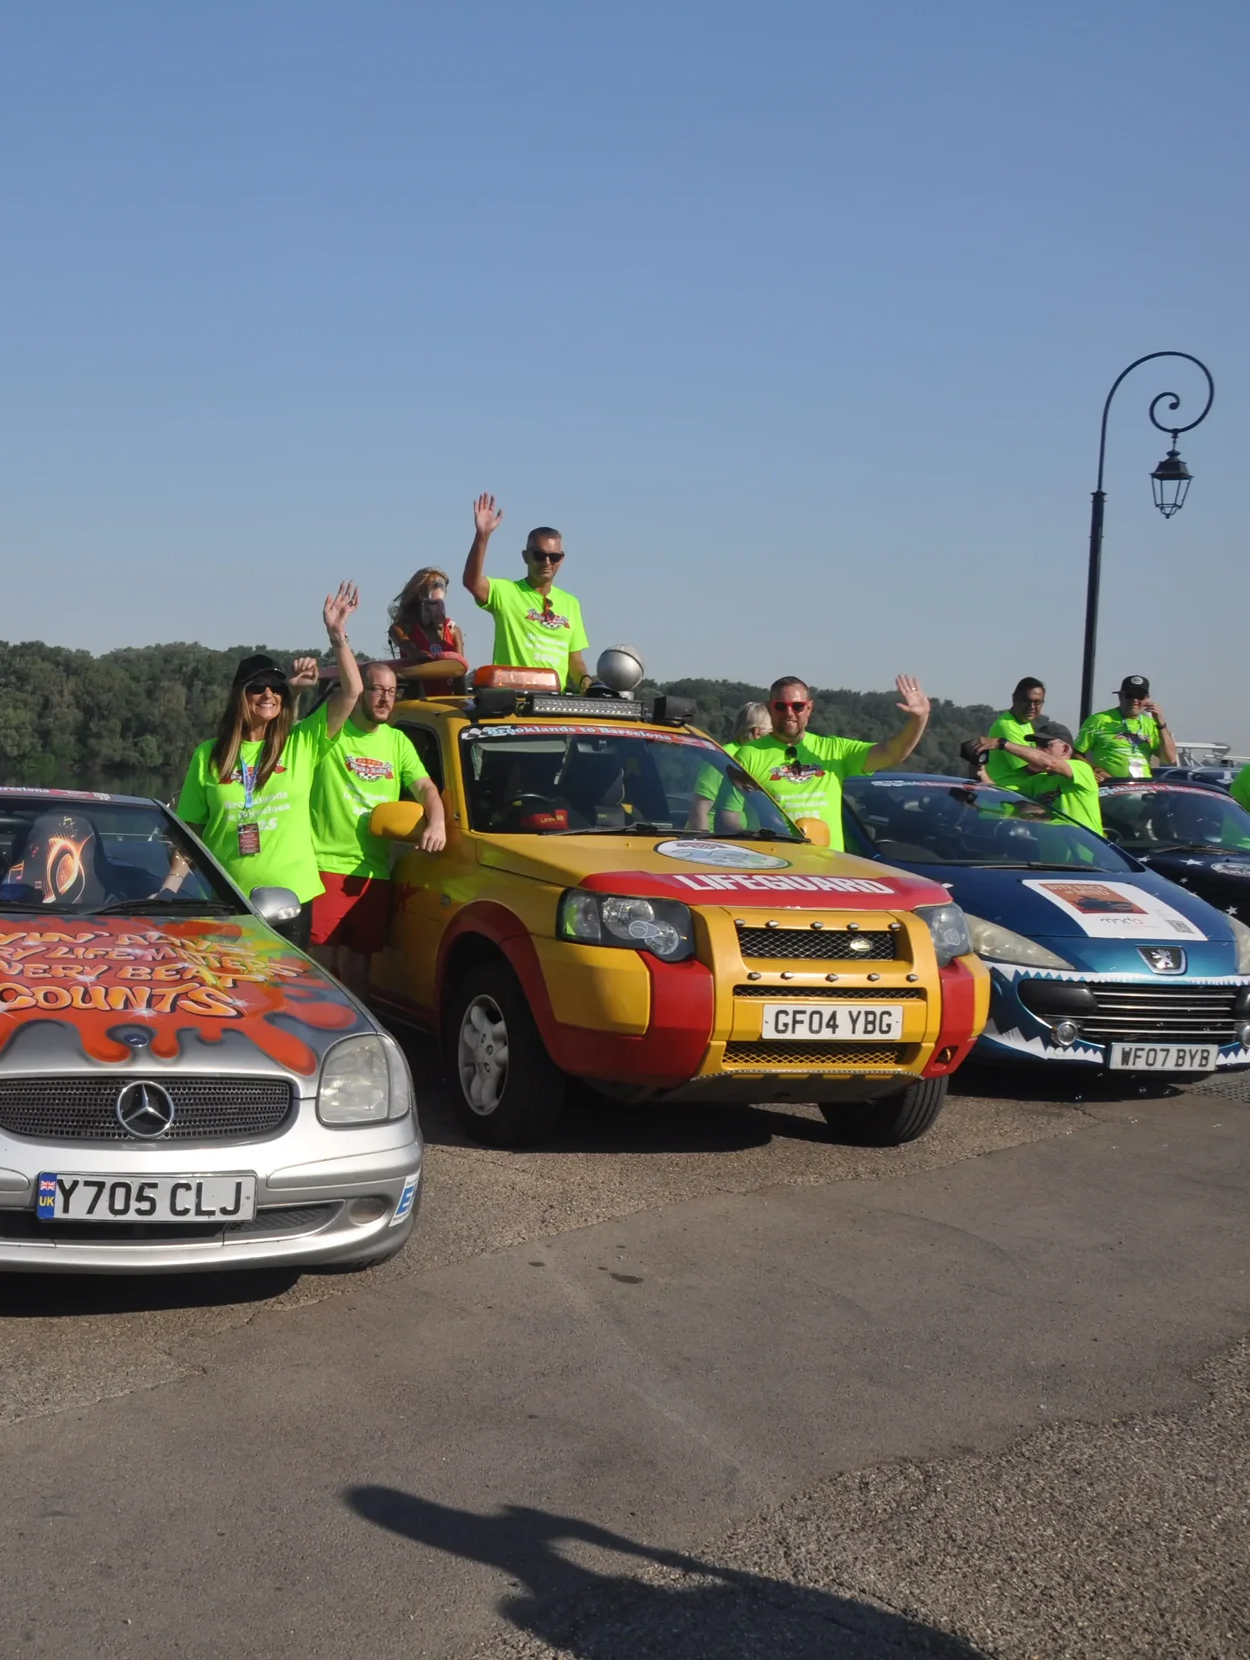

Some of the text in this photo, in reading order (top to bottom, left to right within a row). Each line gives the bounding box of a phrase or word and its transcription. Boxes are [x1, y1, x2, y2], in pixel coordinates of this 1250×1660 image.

[486, 725, 576, 735] Brooklands
[598, 726, 672, 740] Barcelona
[673, 874, 895, 894] LIFEGUARD
[43, 945, 137, 961] LIFE
[141, 946, 306, 978] MATTERS
[115, 962, 268, 988] BEAT
[774, 1009, 893, 1035] GF04 YBG
[1121, 1047, 1211, 1068] WF07 BYB
[39, 1196, 55, 1207] UK
[57, 1179, 243, 1218] Y705 CLJ
